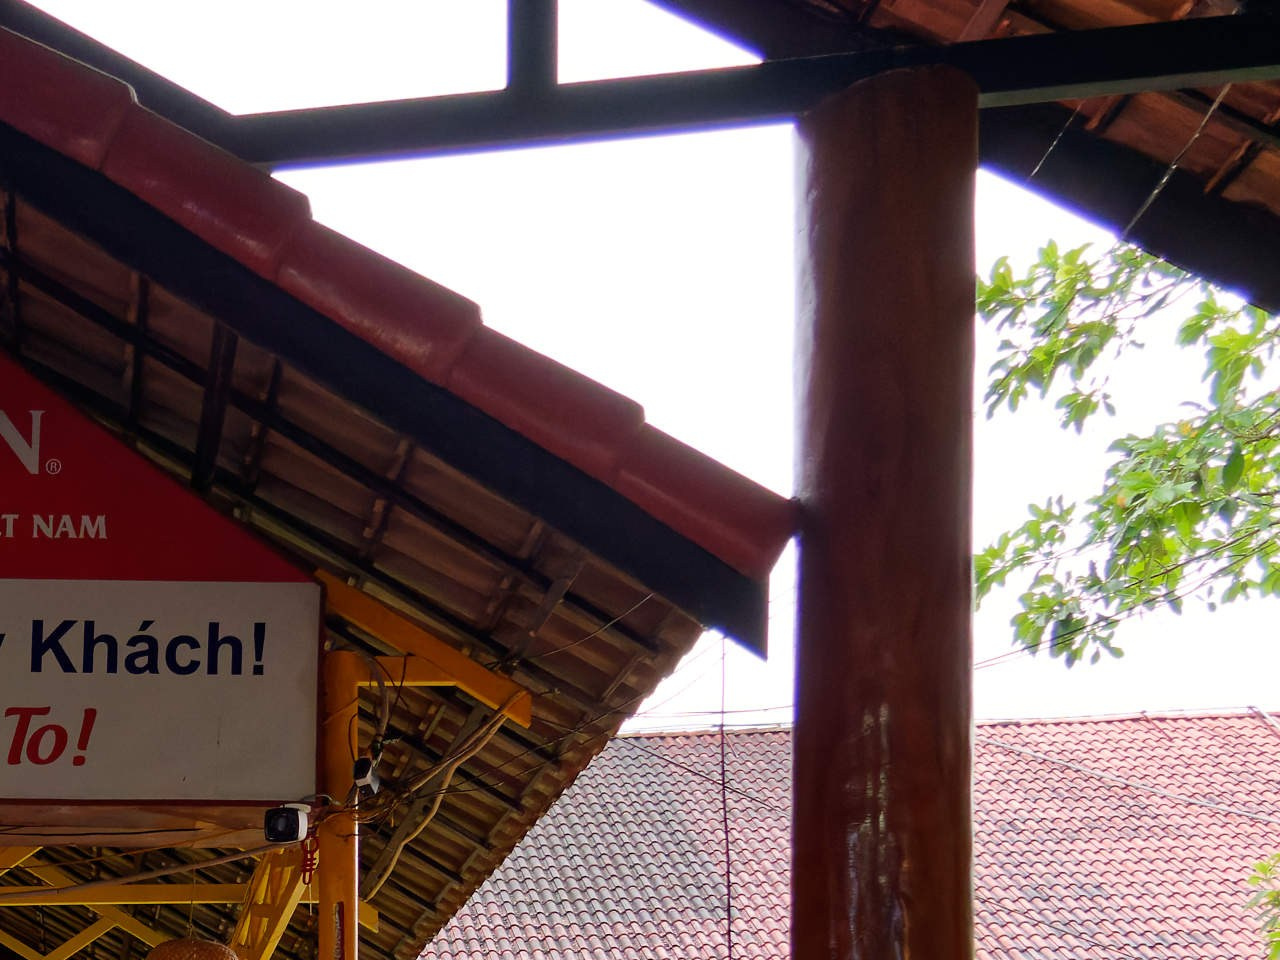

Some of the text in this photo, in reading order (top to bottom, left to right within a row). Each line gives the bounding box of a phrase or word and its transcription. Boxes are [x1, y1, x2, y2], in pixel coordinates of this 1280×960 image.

[32, 514, 108, 540] NAM
[30, 617, 270, 678] Khách!
[4, 706, 98, 766] To!
